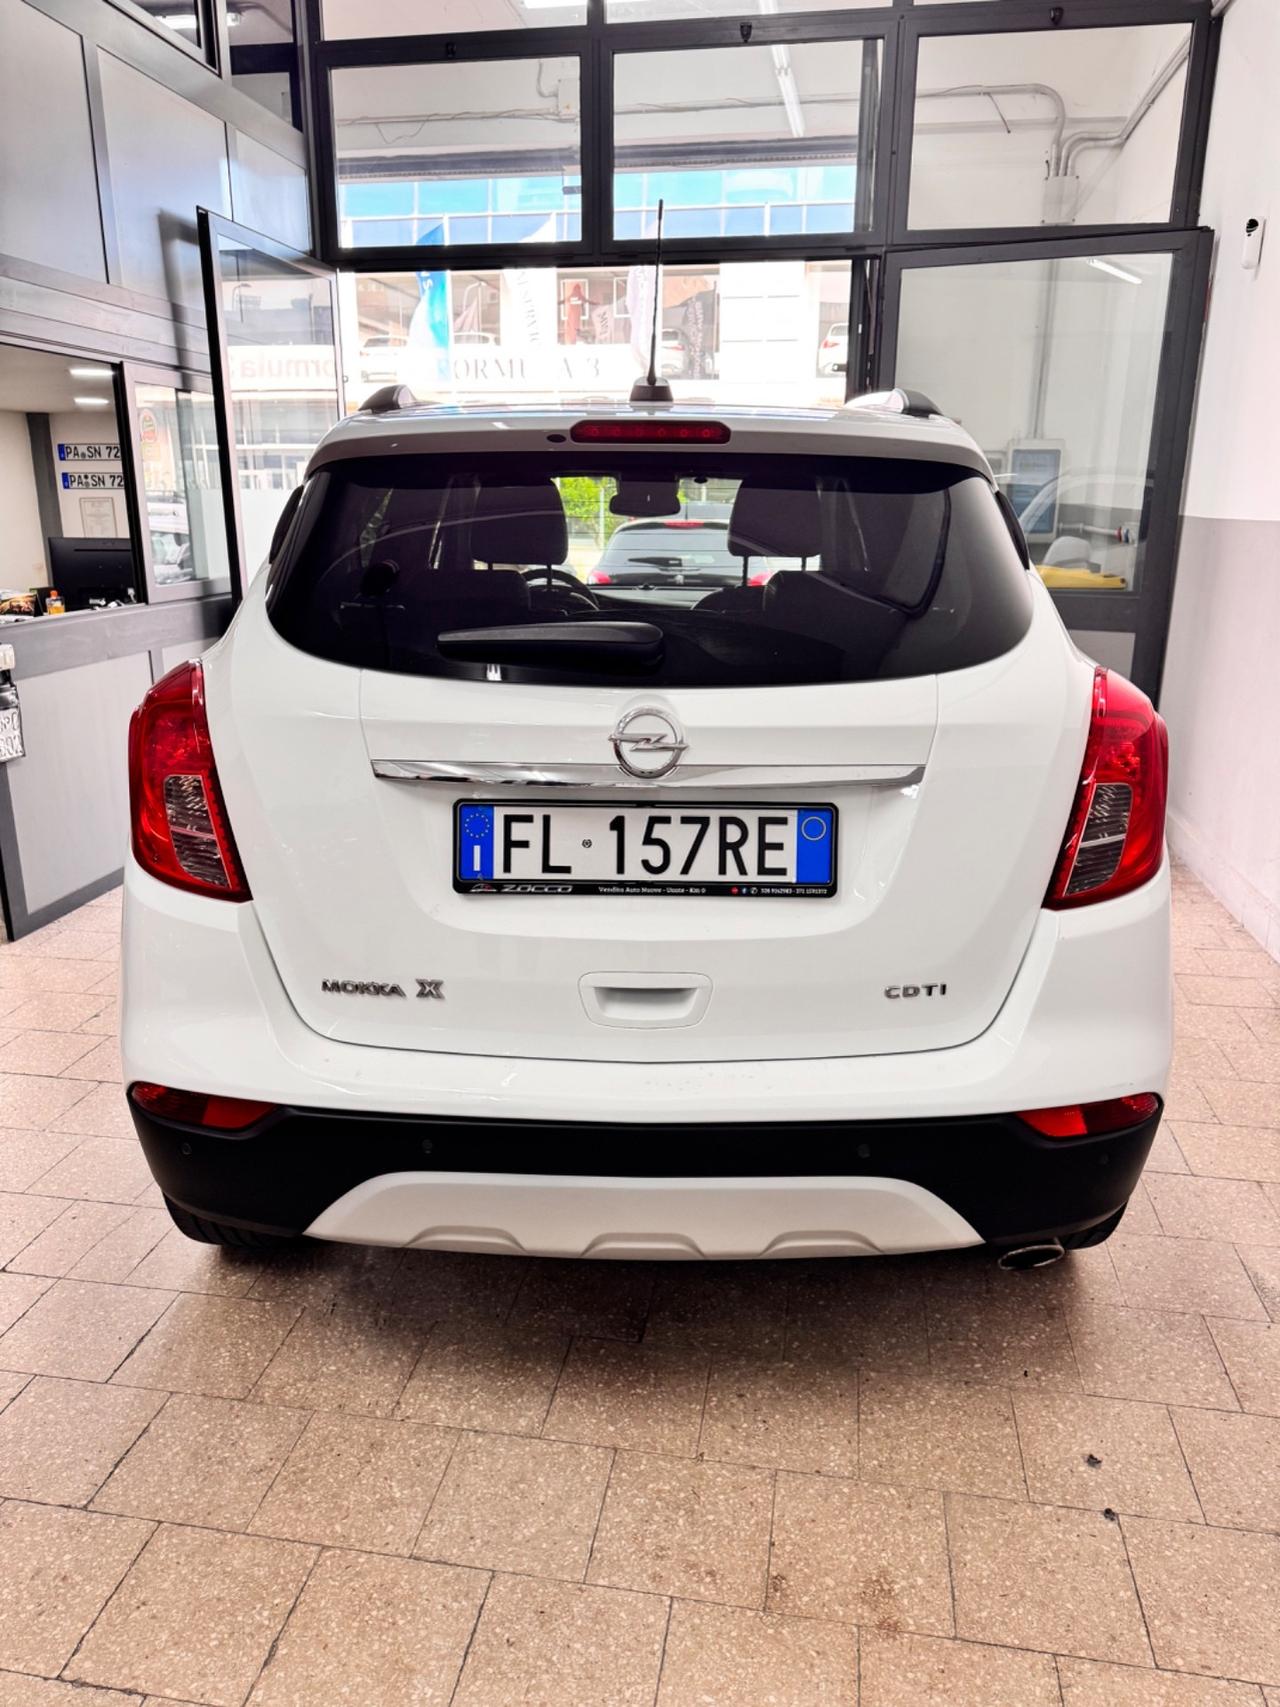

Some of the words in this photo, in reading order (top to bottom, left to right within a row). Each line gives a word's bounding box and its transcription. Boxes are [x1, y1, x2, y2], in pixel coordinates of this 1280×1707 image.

[65, 446, 80, 458] PA
[87, 446, 101, 458] SN
[69, 474, 84, 487] PA
[91, 474, 106, 487] SN
[503, 814, 572, 874] FL
[609, 815, 788, 876] 157RE
[502, 884, 573, 894] ZOCCO
[321, 980, 407, 998] MOKKA
[415, 979, 445, 1000] X
[884, 983, 947, 999] CDTI
